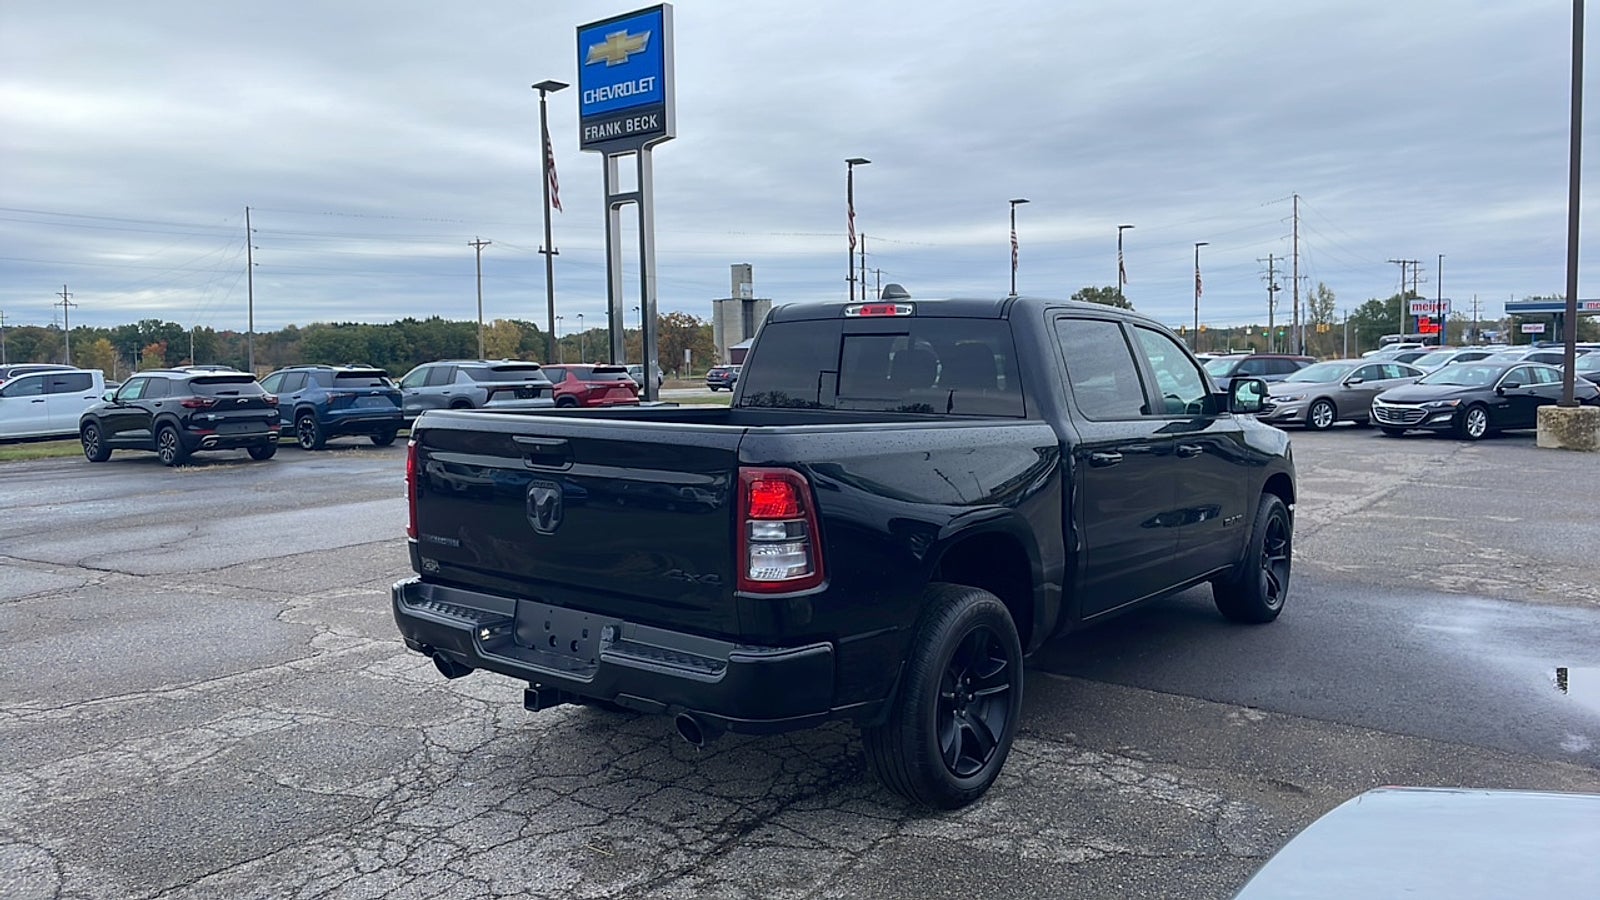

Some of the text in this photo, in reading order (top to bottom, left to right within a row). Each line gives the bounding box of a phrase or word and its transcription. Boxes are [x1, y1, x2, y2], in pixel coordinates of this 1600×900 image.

[583, 76, 656, 105] CHEVROLET
[584, 114, 658, 140] FRANK BECK
